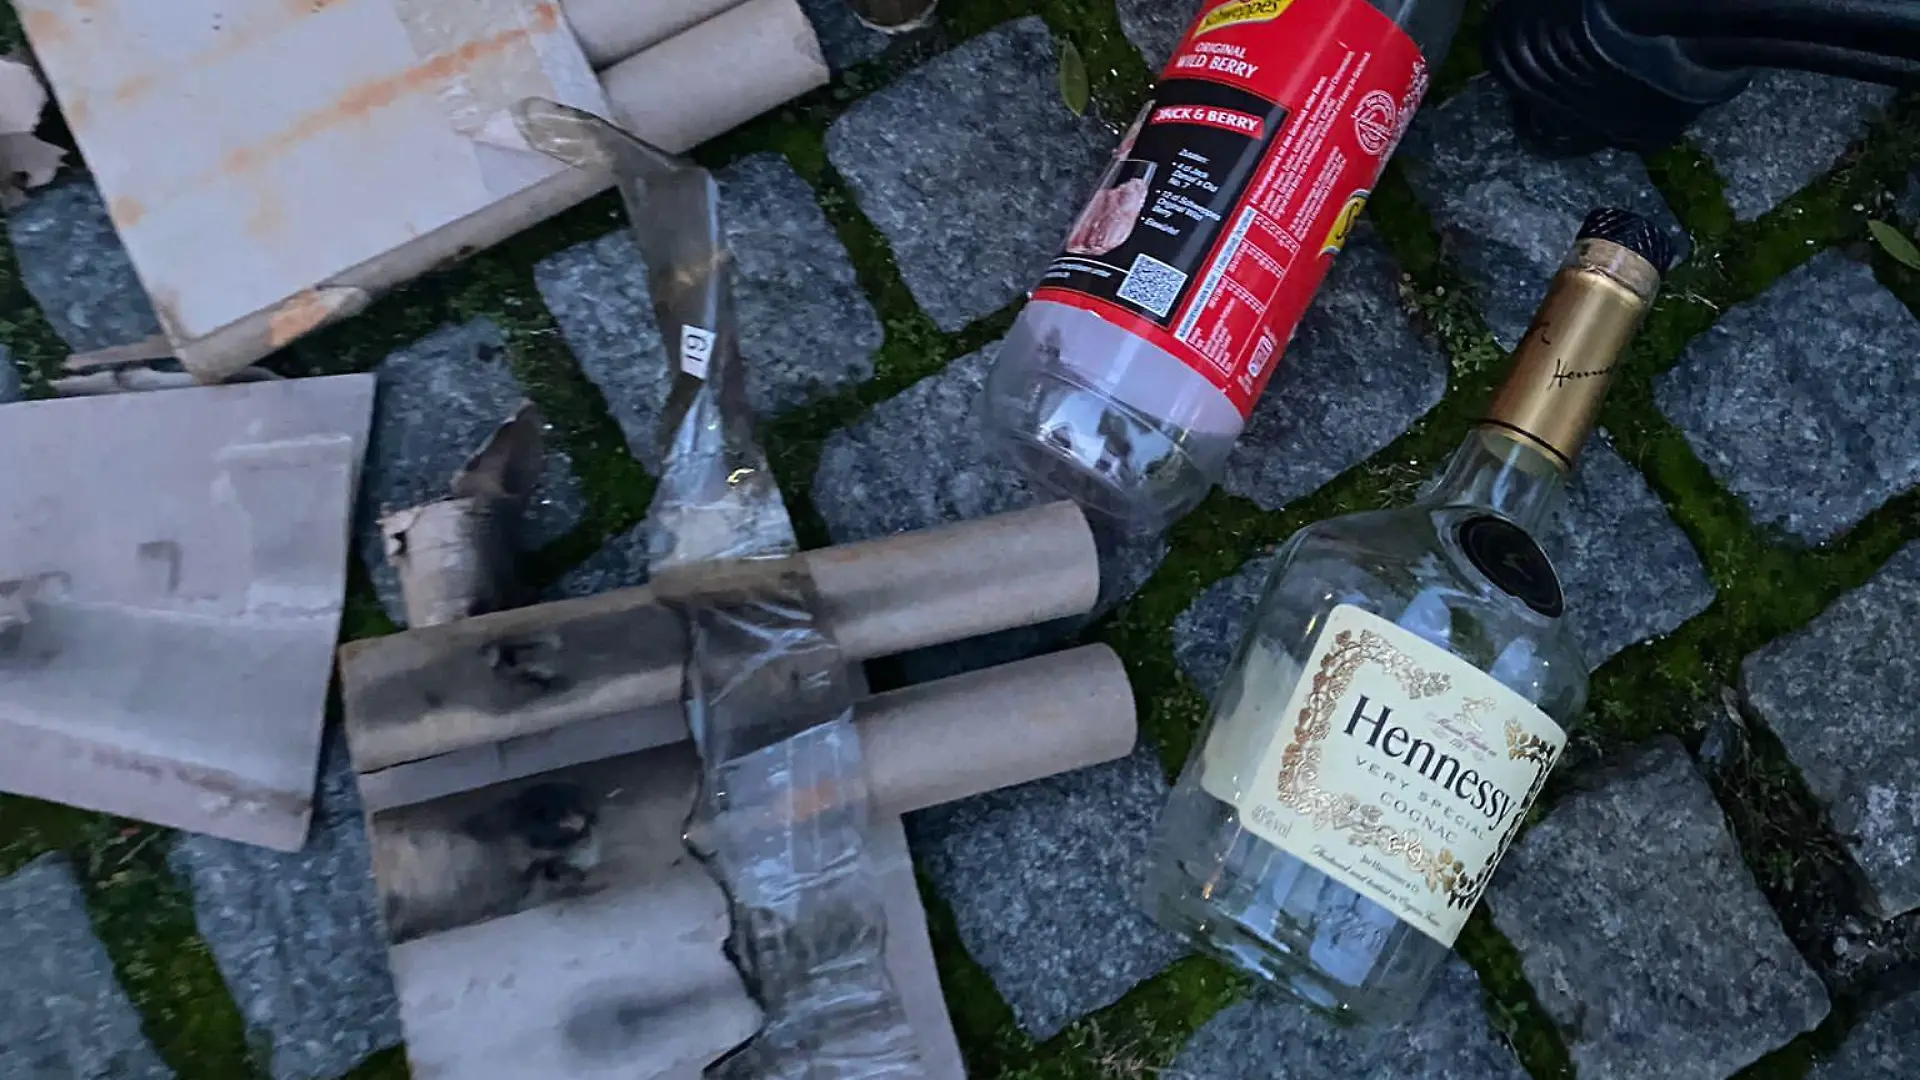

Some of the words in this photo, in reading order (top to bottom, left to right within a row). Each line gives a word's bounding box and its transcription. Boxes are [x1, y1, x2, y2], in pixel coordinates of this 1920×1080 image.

[1176, 55, 1207, 68] WILD
[1209, 56, 1259, 79] BERRY
[1195, 42, 1247, 59] ORIGINAL
[1155, 107, 1191, 121] JACK
[1193, 109, 1205, 120] &
[1207, 110, 1259, 132] BERRY
[1343, 694, 1517, 831] Hennessy
[1355, 753, 1410, 790] VERY
[1417, 791, 1485, 841] SPECIAL
[1380, 791, 1458, 844] COGNAC
